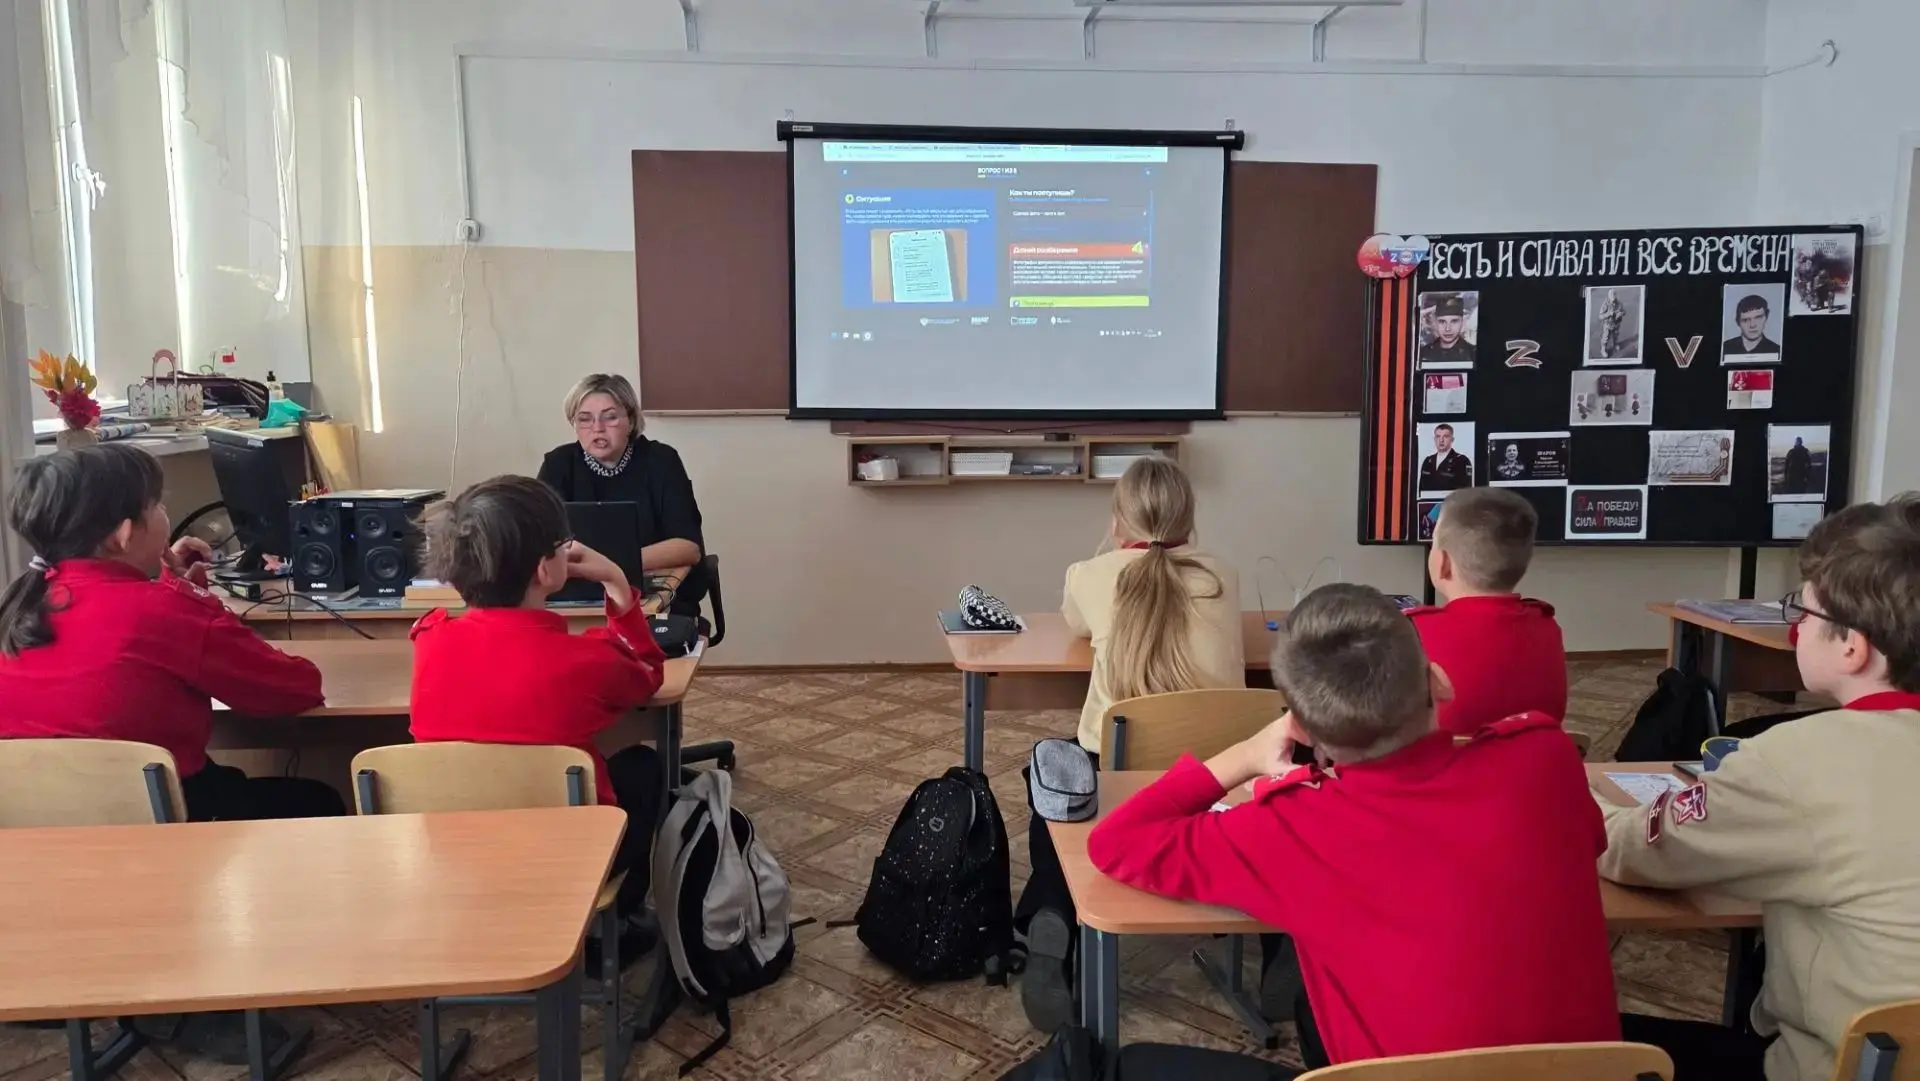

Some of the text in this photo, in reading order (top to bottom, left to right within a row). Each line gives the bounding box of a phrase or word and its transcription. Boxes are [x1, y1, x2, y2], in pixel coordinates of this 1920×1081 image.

[856, 195, 892, 203] Ситуация
[1421, 233, 1790, 279] ЧЕСТЬ И СЛАВА НА ВСЕ ВРЕМЕНА
[1664, 335, 1704, 369] V
[1596, 500, 1639, 511] ПОБЕДУ!
[1575, 516, 1597, 527] СИЛА
[1603, 515, 1639, 527] ПРАВДЕ!
